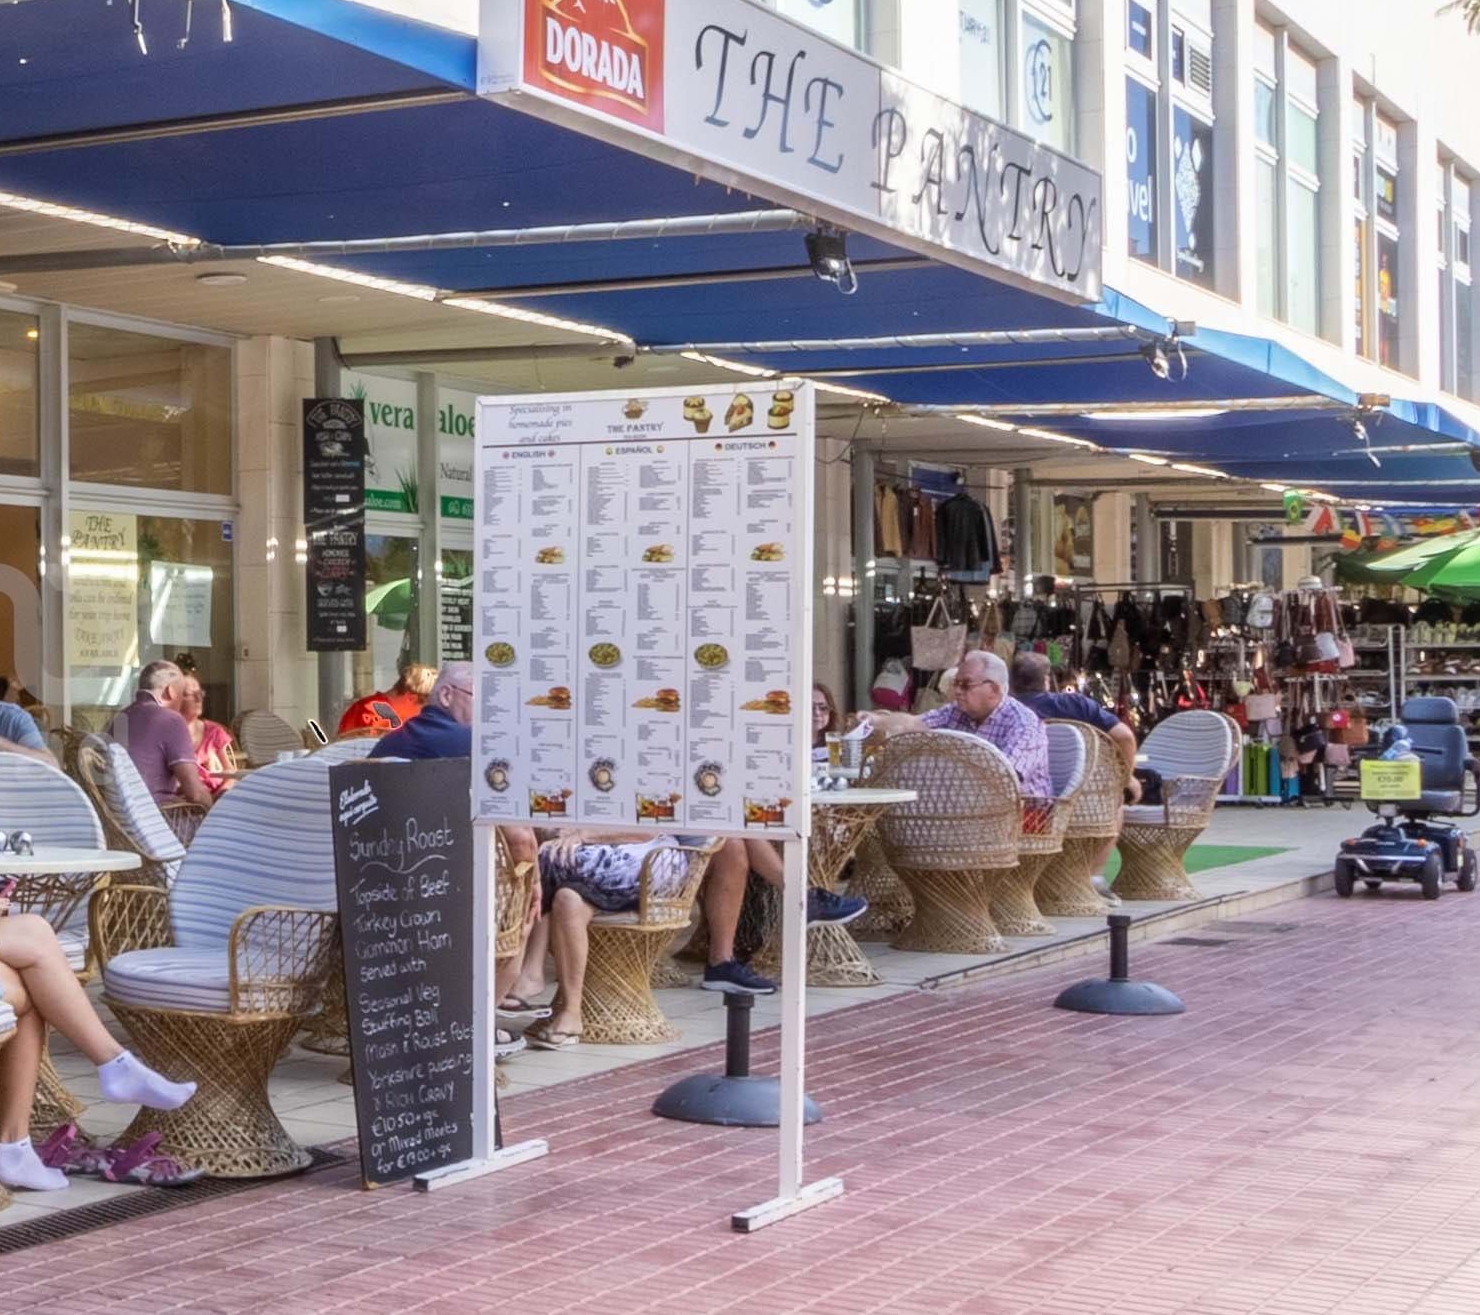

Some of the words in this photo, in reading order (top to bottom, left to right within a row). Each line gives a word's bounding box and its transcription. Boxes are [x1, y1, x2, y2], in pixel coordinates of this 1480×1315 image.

[545, 16, 645, 99] DORADA
[695, 22, 845, 175] THE
[871, 106, 1097, 283] PANTRY
[369, 400, 415, 430] vera
[607, 424, 624, 433] THE
[626, 421, 665, 433] PANTRY
[511, 450, 546, 460] ENGLISH
[615, 444, 653, 455] ESPAÑOL
[725, 441, 767, 452] DEUTSCH
[85, 514, 113, 533] THE
[71, 527, 127, 551] PANTRY
[406, 815, 454, 853] Roast
[402, 875, 415, 901] of
[420, 869, 451, 899] Beef
[353, 912, 397, 939] Turkey
[417, 930, 452, 950] Ham
[399, 956, 427, 974] with
[358, 986, 413, 1014] Seasonal
[416, 982, 441, 1007] Veg
[388, 1129, 422, 1153] Mixed
